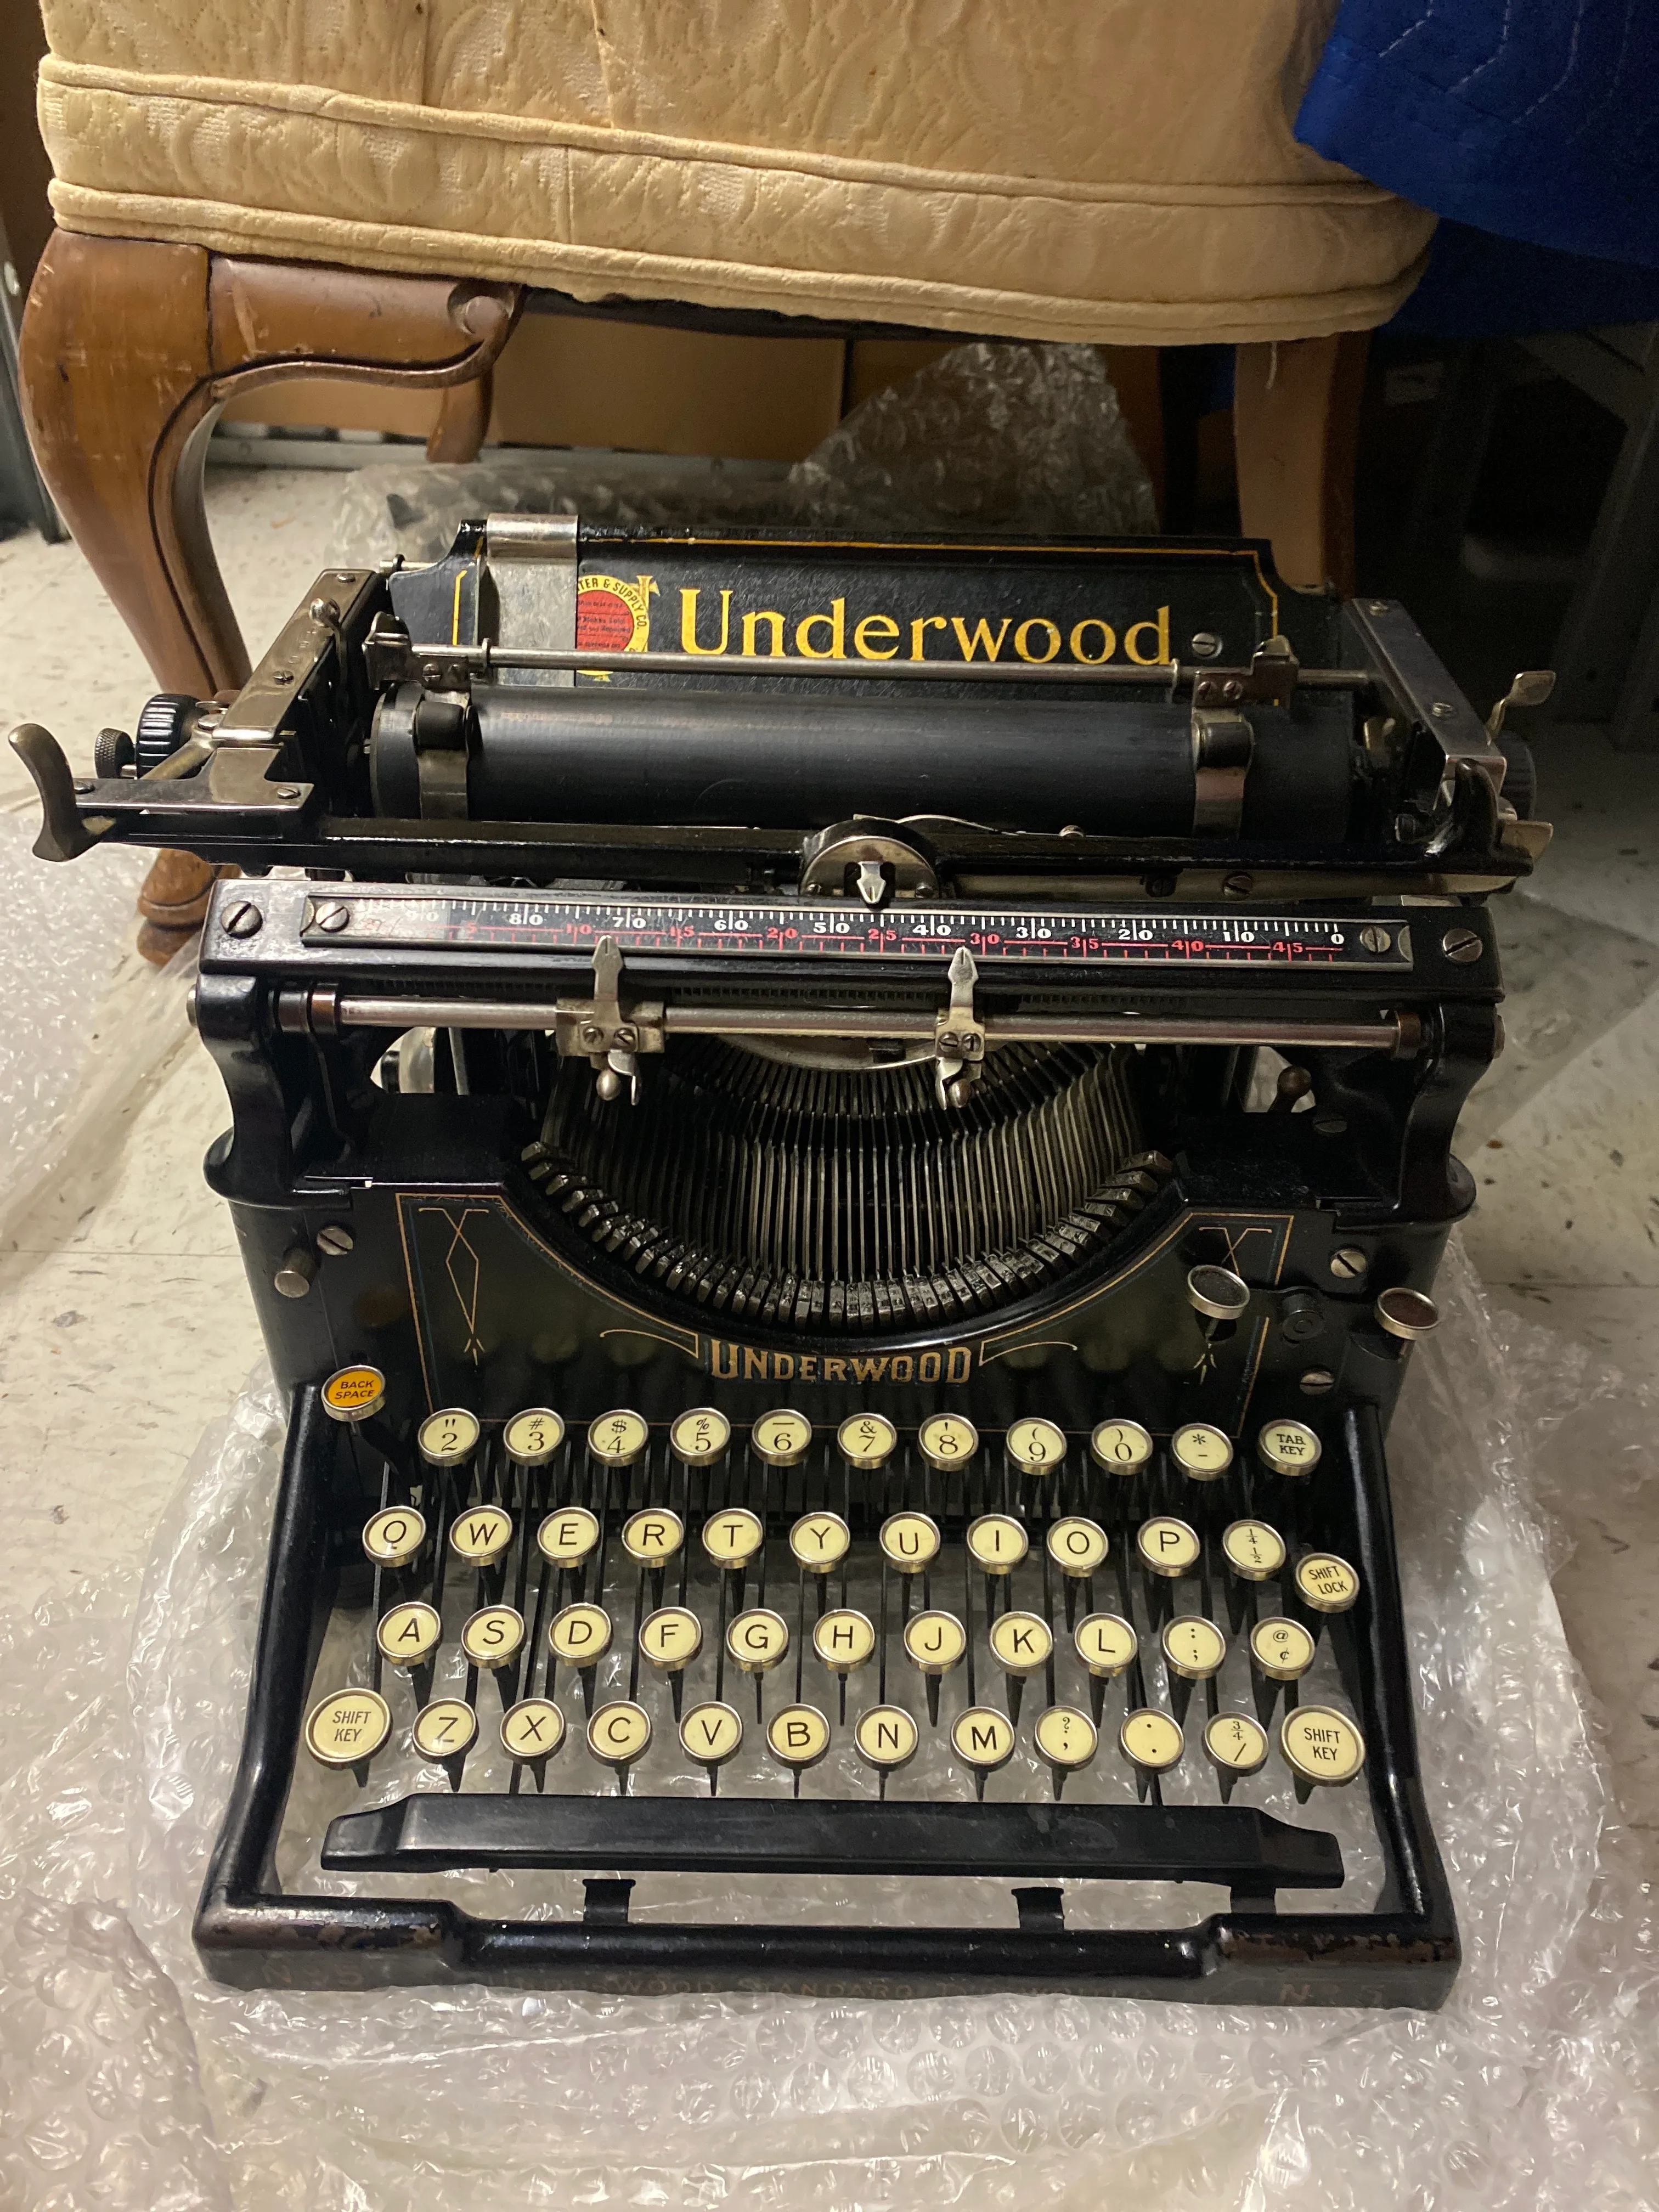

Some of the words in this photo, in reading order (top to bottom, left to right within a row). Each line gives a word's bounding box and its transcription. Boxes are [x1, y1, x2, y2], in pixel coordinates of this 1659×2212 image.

[603, 578, 611, 588] &
[612, 582, 645, 612] SUPPLY
[635, 615, 647, 630] CO.
[679, 589, 1170, 665] Underwood
[509, 914, 543, 926] 80
[612, 917, 646, 929] 70
[714, 918, 749, 931] 60
[813, 922, 850, 934] 50
[912, 924, 951, 936] 40
[1015, 927, 1052, 939] 30
[1118, 929, 1153, 941] 20
[1223, 930, 1255, 943] 10
[1331, 933, 1345, 944] 0
[768, 927, 798, 939] 20
[868, 928, 896, 941] 25
[970, 933, 1000, 944] 30
[1070, 937, 1099, 950] 35
[1171, 940, 1204, 952] 40
[1273, 941, 1304, 953] 45
[712, 1339, 971, 1384] UNDERWOOD
[335, 1390, 375, 1400] SPACE
[340, 1380, 374, 1389] BACK
[529, 1418, 545, 1430] #
[612, 1419, 627, 1434] $
[696, 1418, 709, 1430] %
[860, 1421, 877, 1434] &
[441, 1432, 458, 1452] 2
[527, 1431, 545, 1451] 3
[607, 1436, 625, 1454] 4
[695, 1432, 712, 1452] 5
[774, 1433, 792, 1451] 6
[859, 1436, 876, 1452] 7
[939, 1435, 958, 1454] 8
[1276, 1434, 1307, 1446] TAB
[1279, 1444, 1305, 1456] KEY
[1028, 1442, 1046, 1462] 9
[470, 1523, 499, 1546] W
[558, 1523, 579, 1545] E
[642, 1523, 665, 1546] R
[723, 1525, 743, 1547] T
[810, 1527, 831, 1550] Y
[899, 1532, 919, 1555] U
[1159, 1530, 1180, 1552] P
[1307, 1565, 1341, 1582] SHIFT
[1317, 1581, 1348, 1594] LOCK
[397, 1618, 420, 1643] A
[482, 1620, 505, 1645] S
[568, 1620, 592, 1645] D
[661, 1623, 679, 1647] F
[744, 1624, 769, 1649] G
[833, 1625, 853, 1649] H
[924, 1627, 942, 1651] J
[1013, 1629, 1035, 1654] K
[1098, 1628, 1116, 1654] L
[1273, 1630, 1289, 1643] @
[332, 1711, 372, 1724] SHIFT
[520, 1715, 546, 1741] X
[1062, 1717, 1070, 1734] ?
[334, 1728, 362, 1742] KEY
[437, 1717, 459, 1743] Z
[607, 1717, 631, 1743] C
[701, 1719, 723, 1746] V
[787, 1722, 811, 1747] B
[878, 1723, 898, 1749] N
[971, 1725, 997, 1751] M
[1304, 1727, 1340, 1744] SHIFT
[1312, 1746, 1338, 1761] KEY
